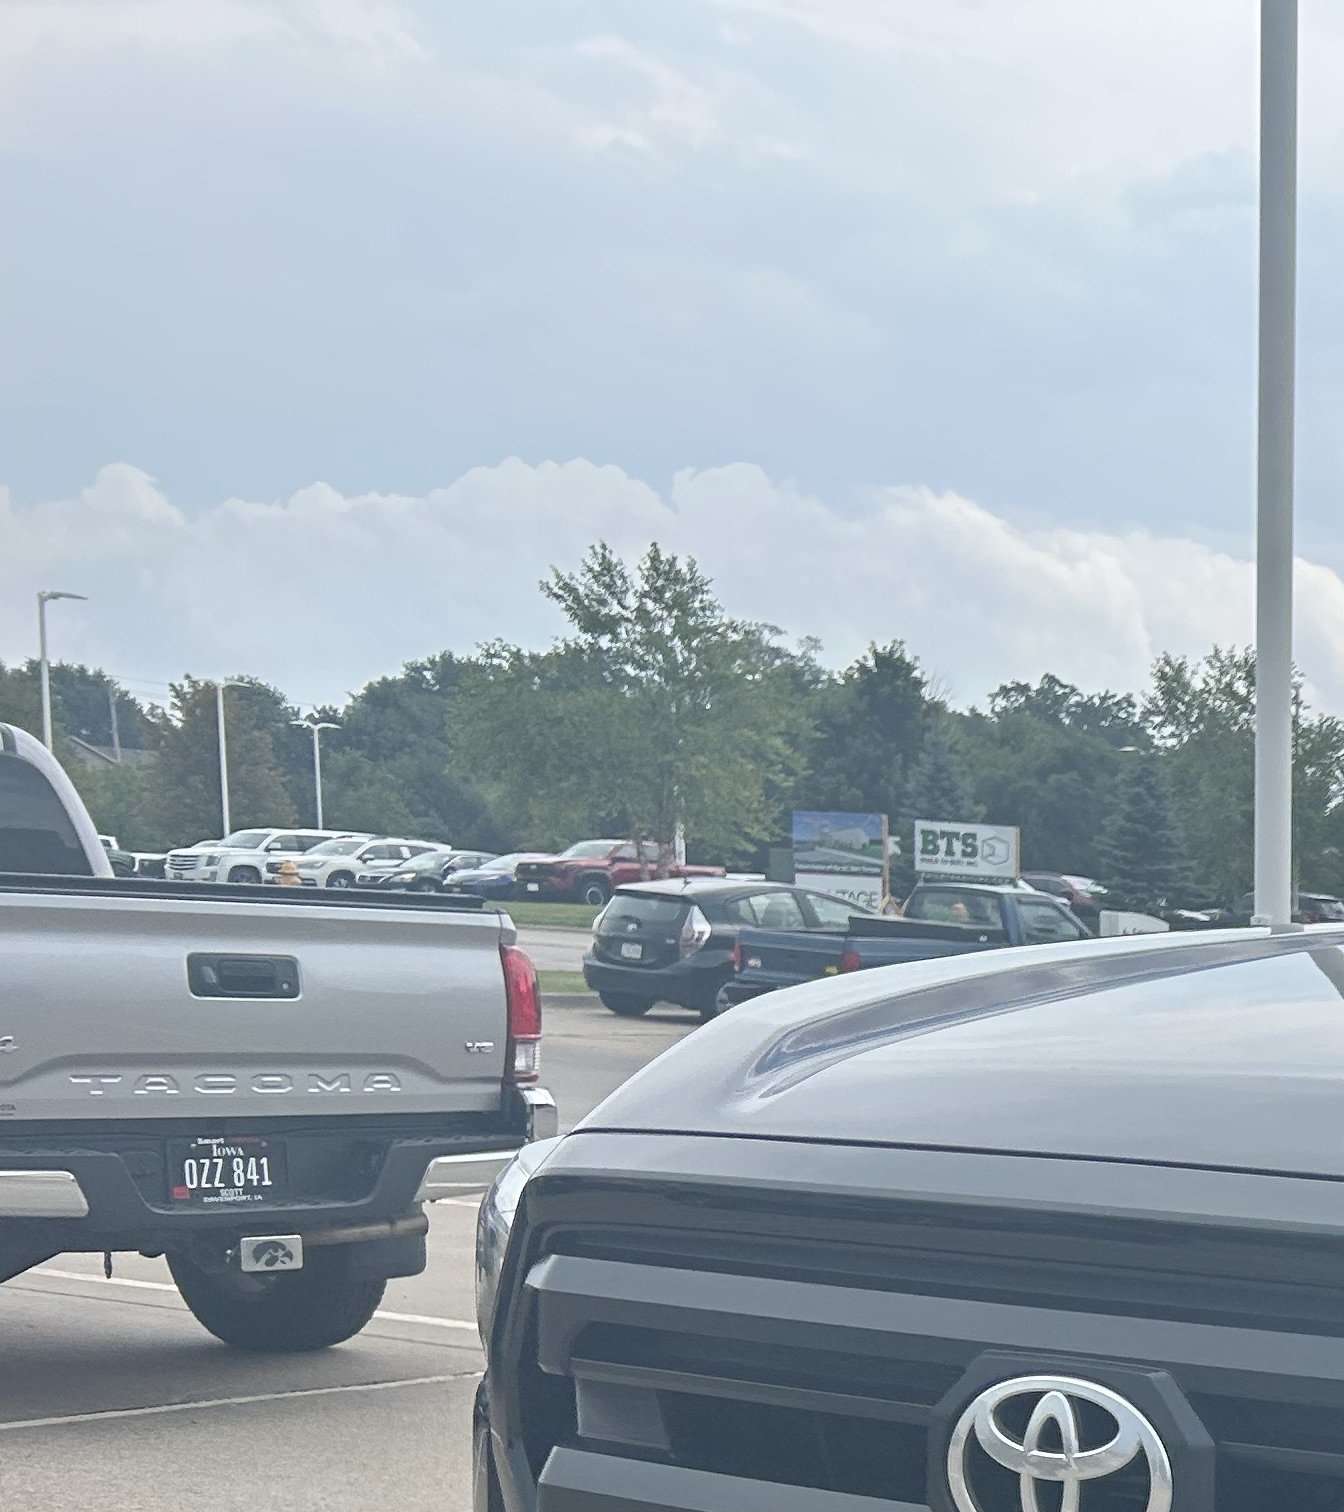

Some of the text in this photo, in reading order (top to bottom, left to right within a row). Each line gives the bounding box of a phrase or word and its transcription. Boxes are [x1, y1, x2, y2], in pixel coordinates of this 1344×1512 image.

[920, 829, 978, 859] BTS
[70, 1073, 401, 1095] TACOMA
[232, 1156, 273, 1187] 841
